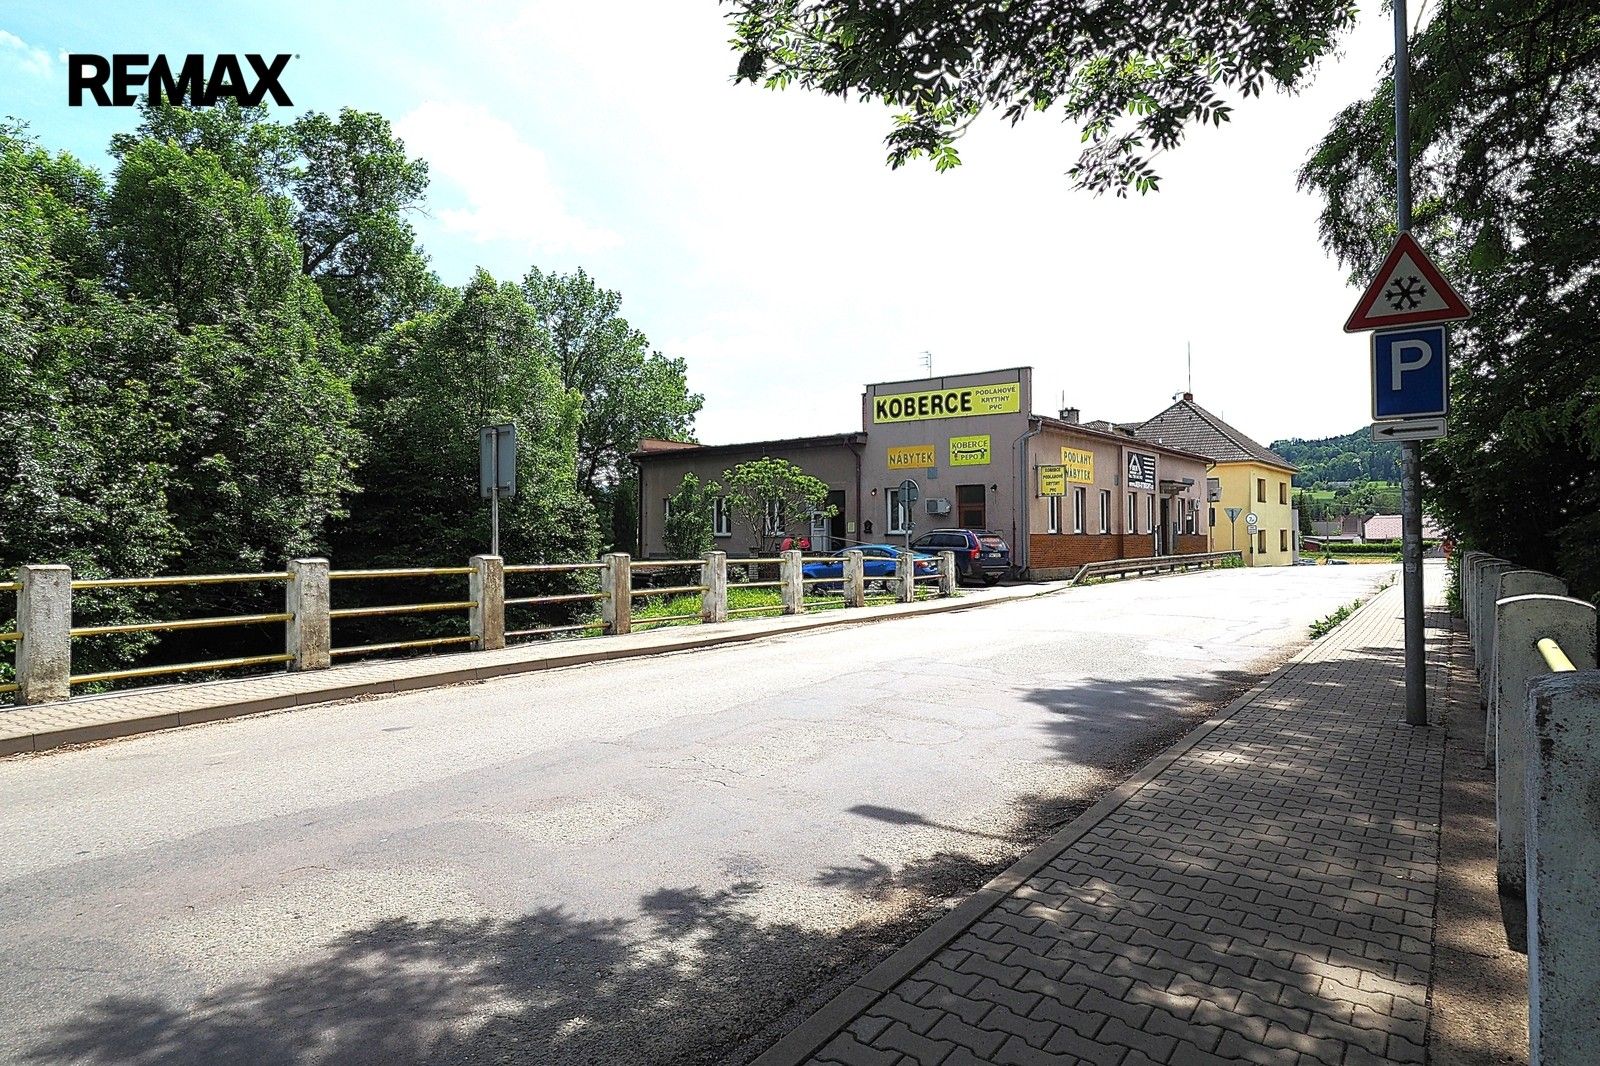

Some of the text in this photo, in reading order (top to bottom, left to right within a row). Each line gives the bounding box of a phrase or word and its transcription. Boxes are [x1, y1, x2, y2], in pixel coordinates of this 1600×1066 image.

[1391, 339, 1432, 391] P
[975, 385, 1016, 396] PODLAHOVÉ
[876, 391, 973, 420] KOBERCE
[981, 395, 1010, 403] KRYTINY
[952, 440, 988, 449] KOBERCE
[889, 450, 933, 465] NÁBYTEK
[1063, 451, 1092, 465] PODLAHY
